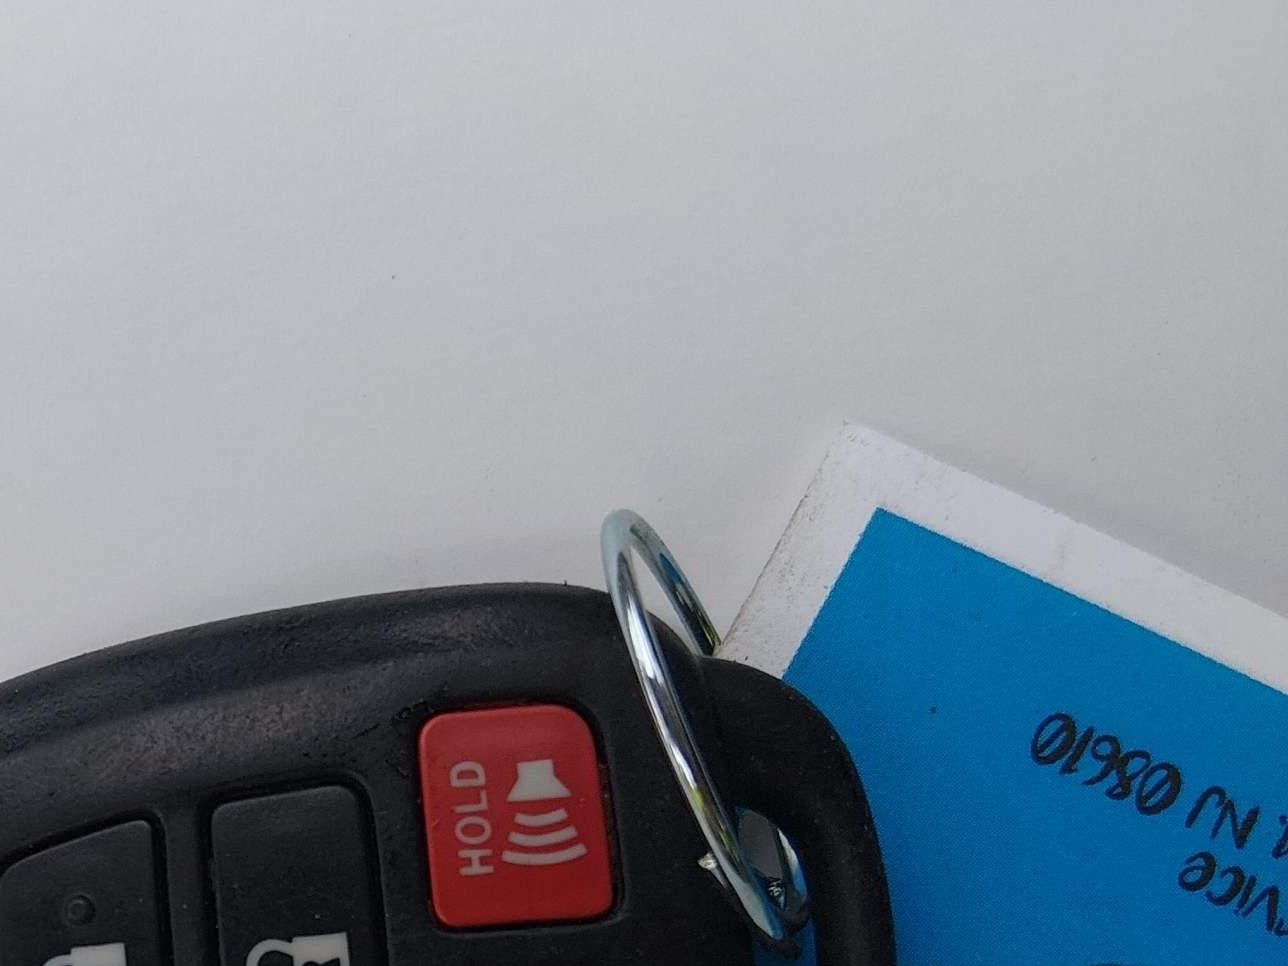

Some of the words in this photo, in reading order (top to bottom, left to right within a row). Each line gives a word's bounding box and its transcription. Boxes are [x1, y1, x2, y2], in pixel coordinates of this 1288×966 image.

[1030, 712, 1182, 816] 08610
[449, 760, 494, 876] HOLD
[1185, 785, 1260, 850] NJ
